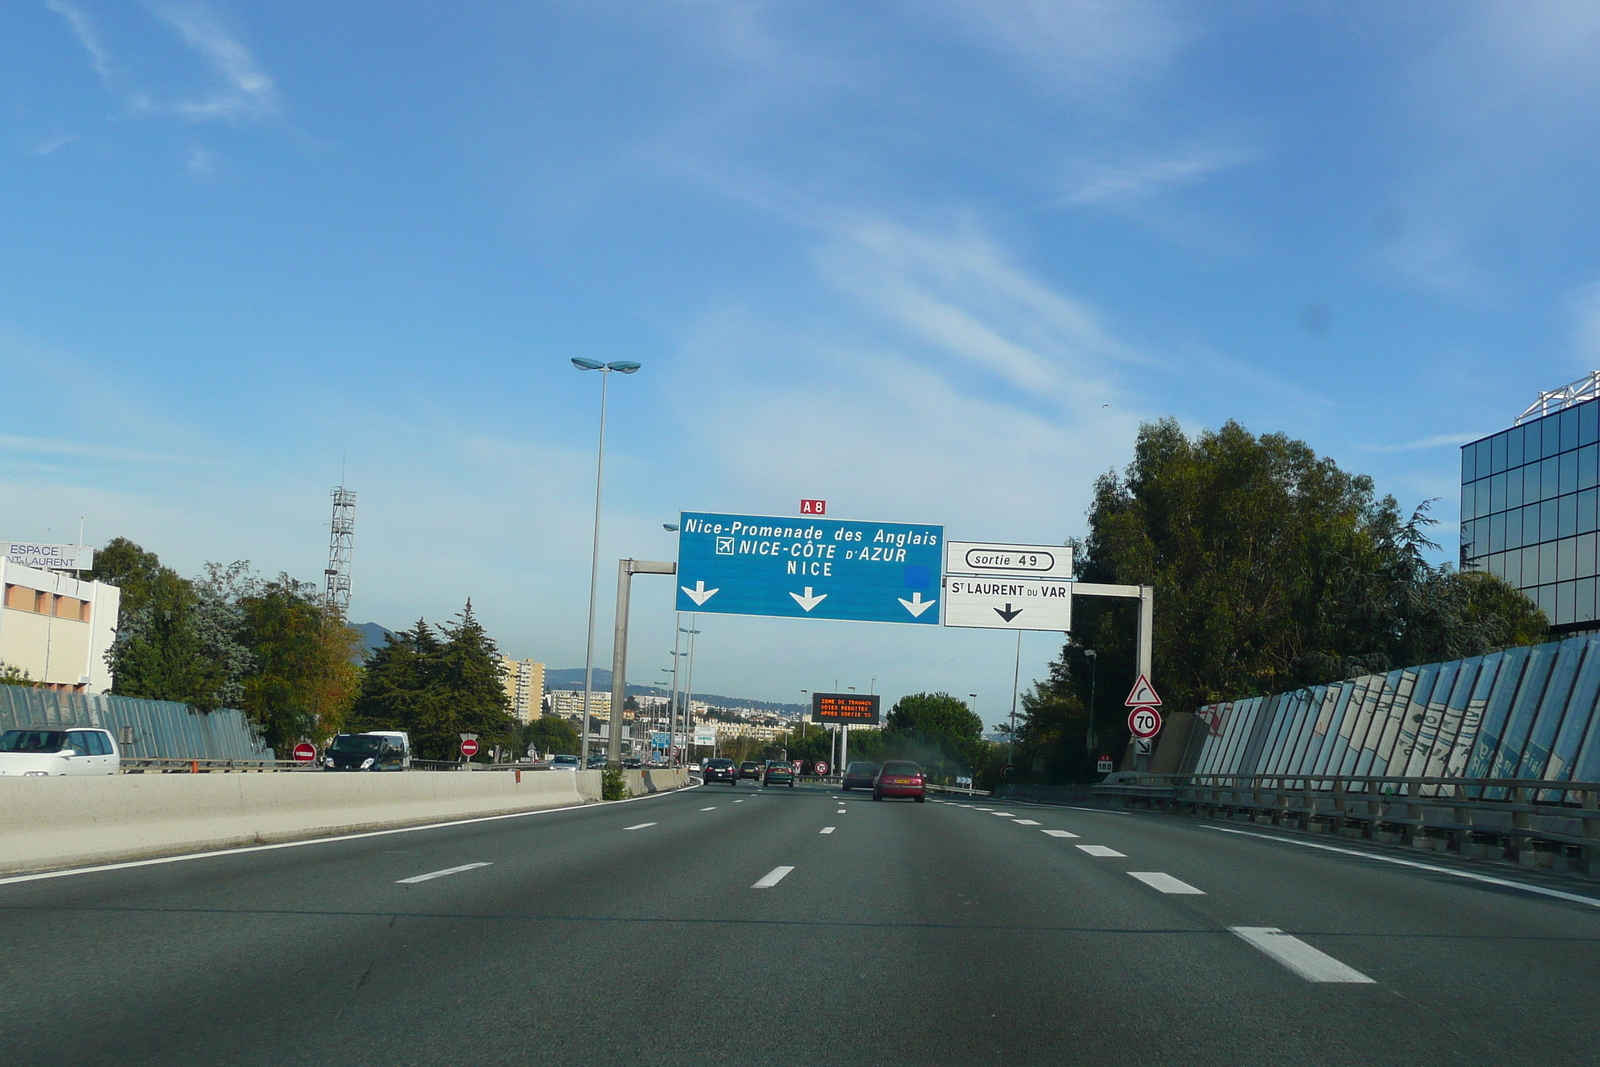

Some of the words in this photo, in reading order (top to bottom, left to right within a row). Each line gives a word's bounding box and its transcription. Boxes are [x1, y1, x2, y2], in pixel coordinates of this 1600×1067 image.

[685, 518, 823, 540] Nice-Promenade
[834, 526, 863, 542] des
[873, 528, 938, 547] Anglais
[10, 544, 58, 556] ESPACE
[738, 540, 836, 558] NICE-CÔTE
[974, 554, 1011, 565] sortie
[1018, 555, 1037, 566] 49
[787, 560, 832, 577] NICE
[967, 582, 1025, 596] LAURENT
[1027, 589, 1038, 597] DU
[1041, 586, 1066, 598] VAR
[1136, 715, 1155, 729] 70
